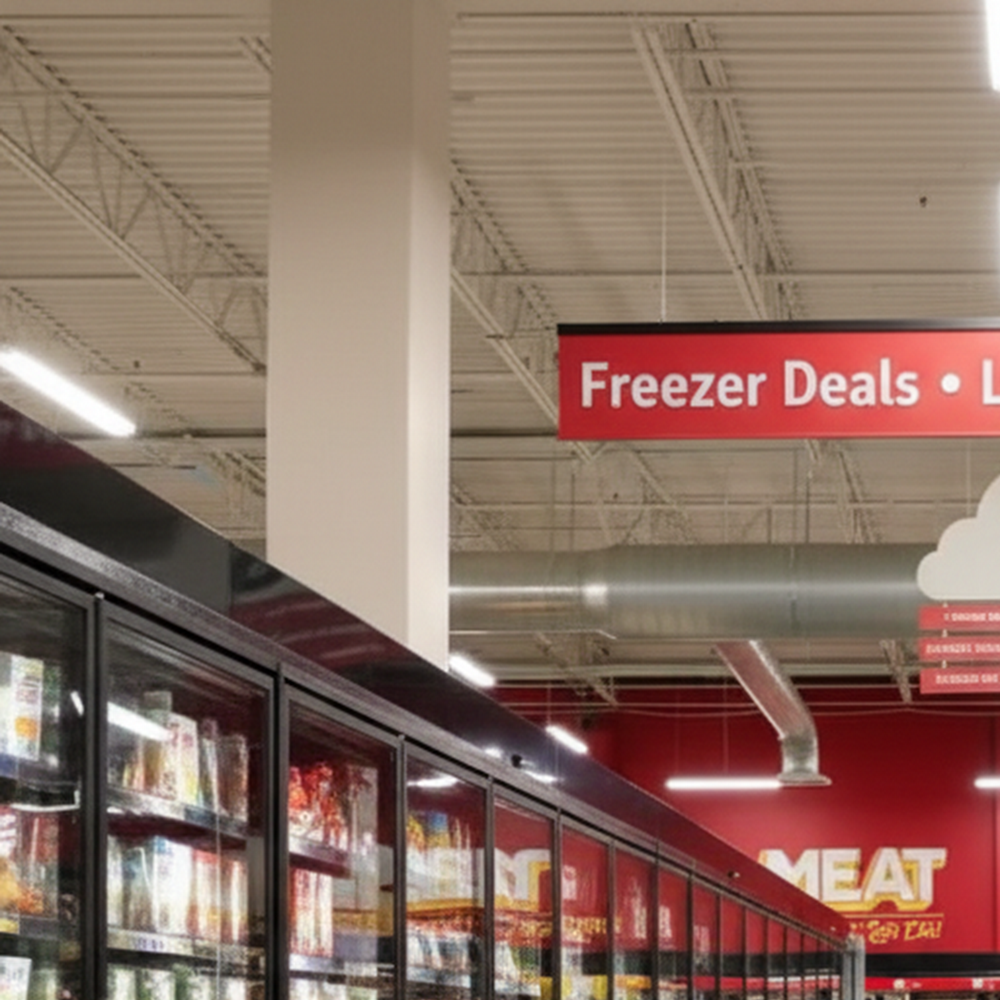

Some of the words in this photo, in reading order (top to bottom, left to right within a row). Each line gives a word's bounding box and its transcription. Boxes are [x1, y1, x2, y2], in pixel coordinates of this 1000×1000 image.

[581, 360, 769, 409] Freezer
[783, 357, 923, 408] Deals
[756, 846, 948, 912] MEAT
